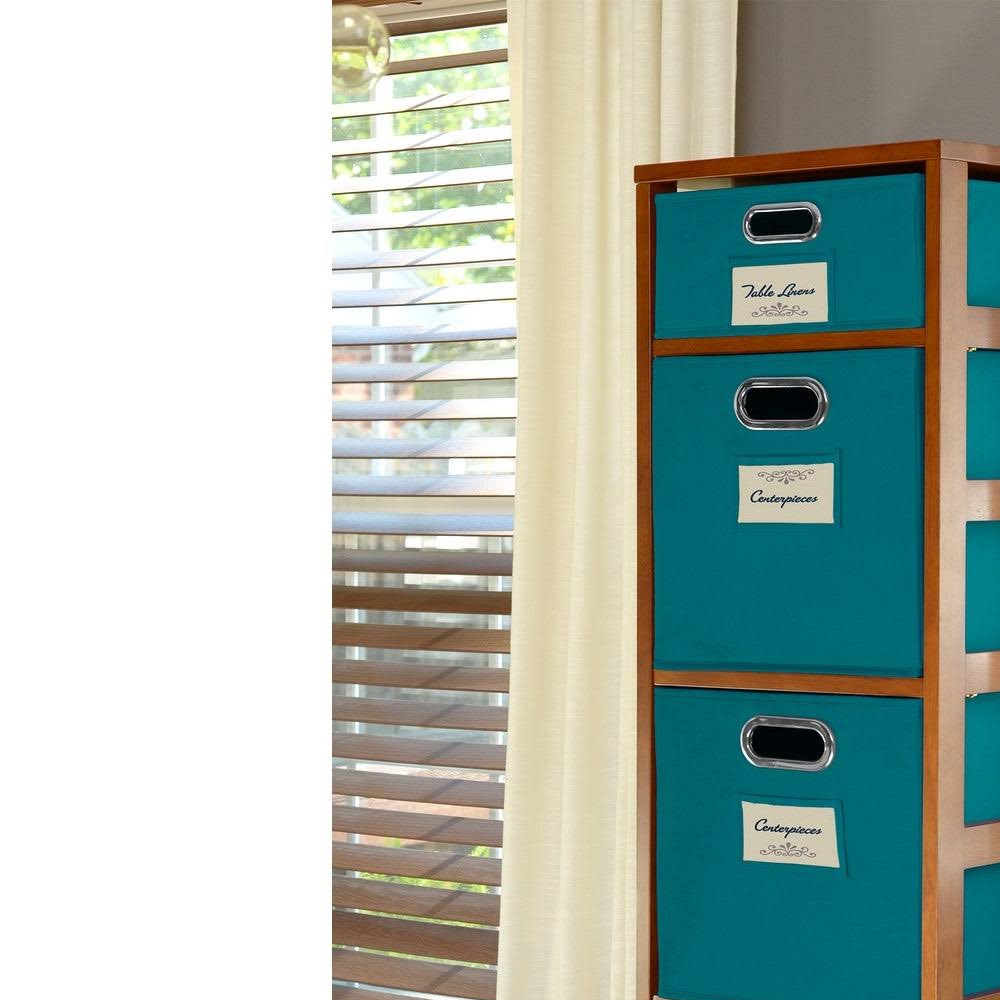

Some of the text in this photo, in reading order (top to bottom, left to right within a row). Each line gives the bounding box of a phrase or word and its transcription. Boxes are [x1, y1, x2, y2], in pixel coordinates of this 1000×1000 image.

[741, 283, 816, 299] Table Linens
[750, 489, 819, 508] Centerpieces
[754, 818, 822, 838] Centerpieces
